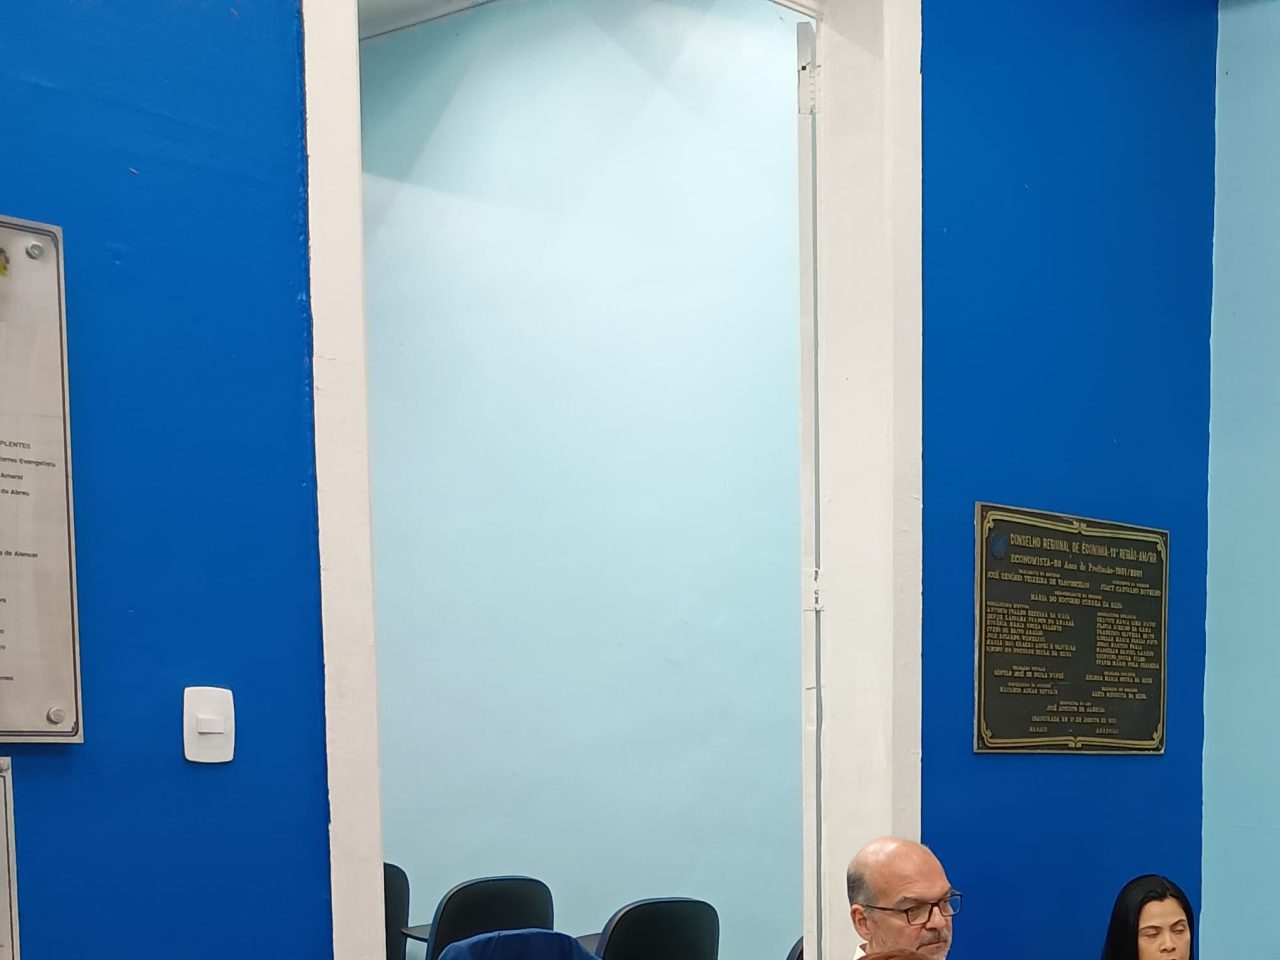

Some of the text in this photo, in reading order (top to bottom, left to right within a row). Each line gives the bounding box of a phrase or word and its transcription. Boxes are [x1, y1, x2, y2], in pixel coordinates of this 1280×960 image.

[1010, 533, 1041, 548] CONSELHO
[1043, 539, 1070, 552] REGIONAL
[1072, 542, 1080, 554] DE
